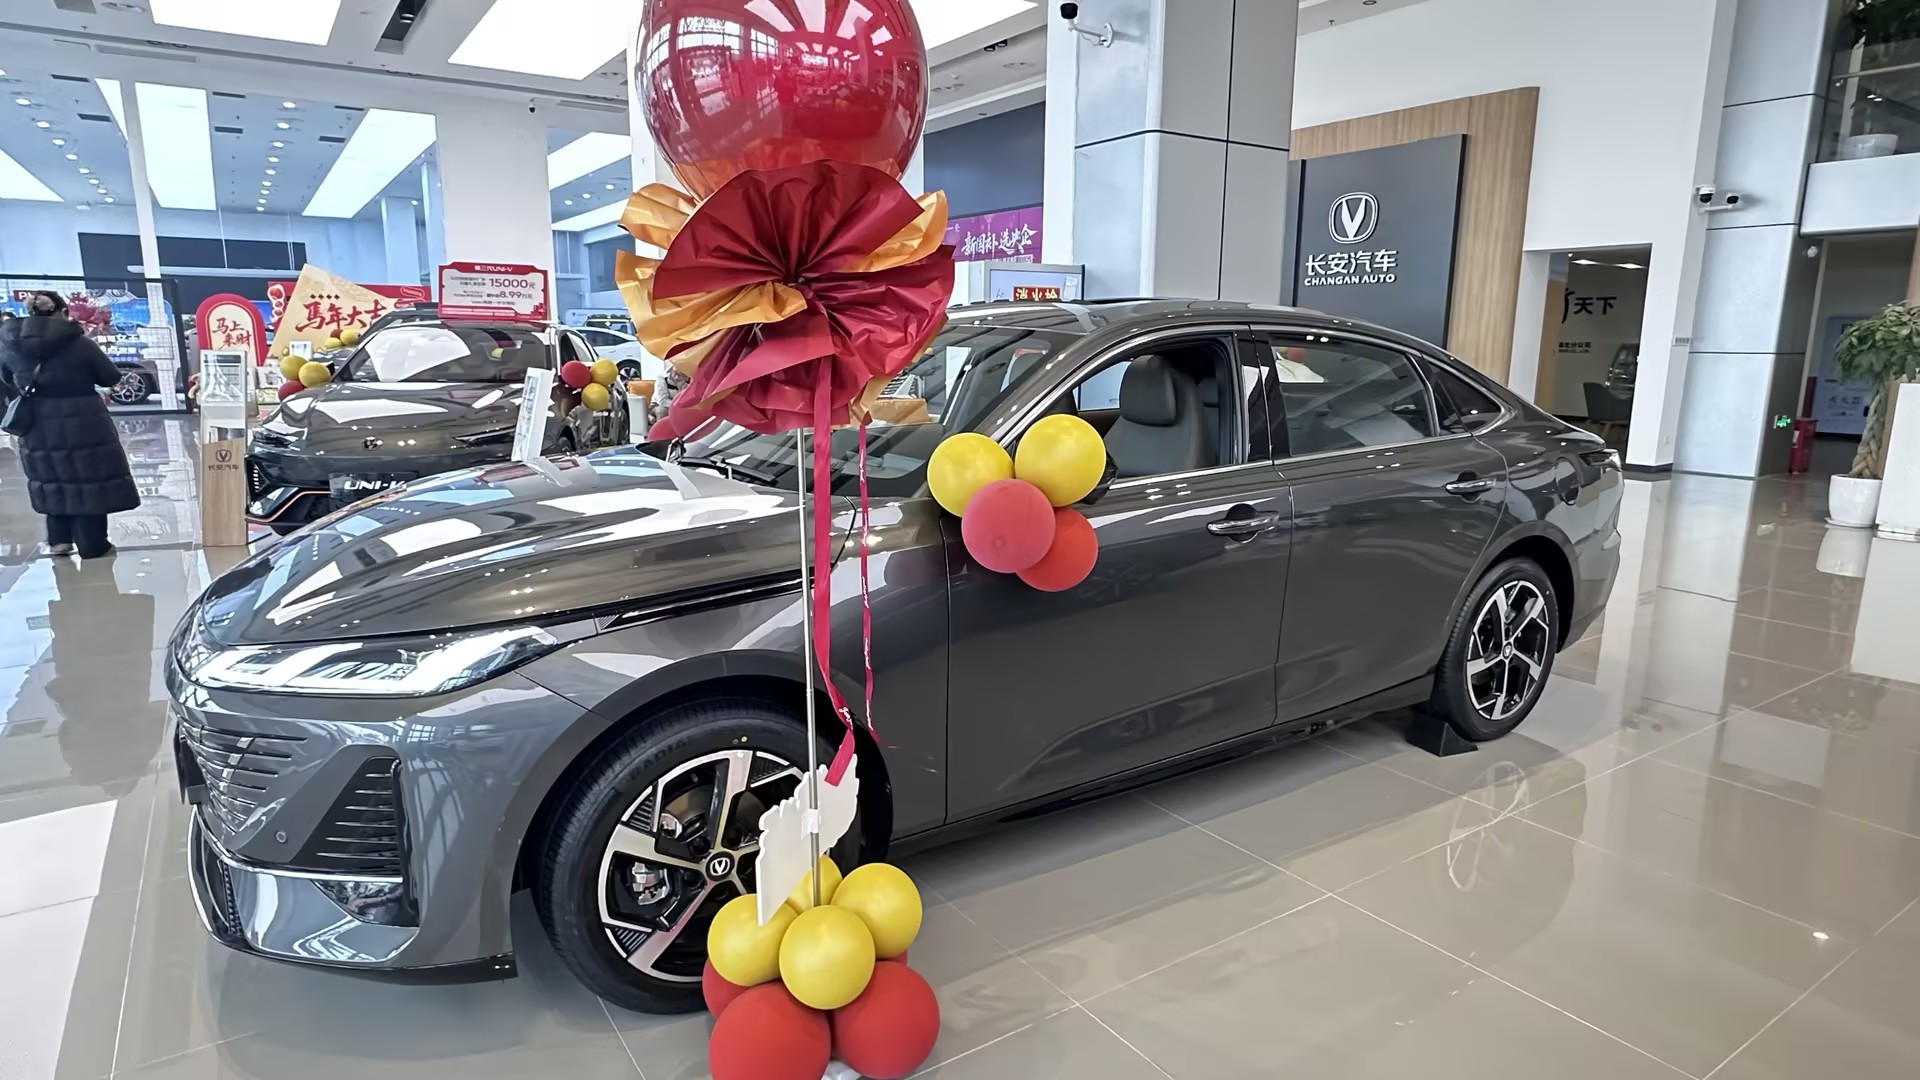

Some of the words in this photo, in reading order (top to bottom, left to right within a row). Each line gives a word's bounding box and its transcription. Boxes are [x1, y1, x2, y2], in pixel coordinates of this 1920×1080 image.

[1305, 249, 1397, 275] 长安汽车
[1304, 275, 1359, 286] CHANGAN
[1361, 273, 1395, 284] AUTO
